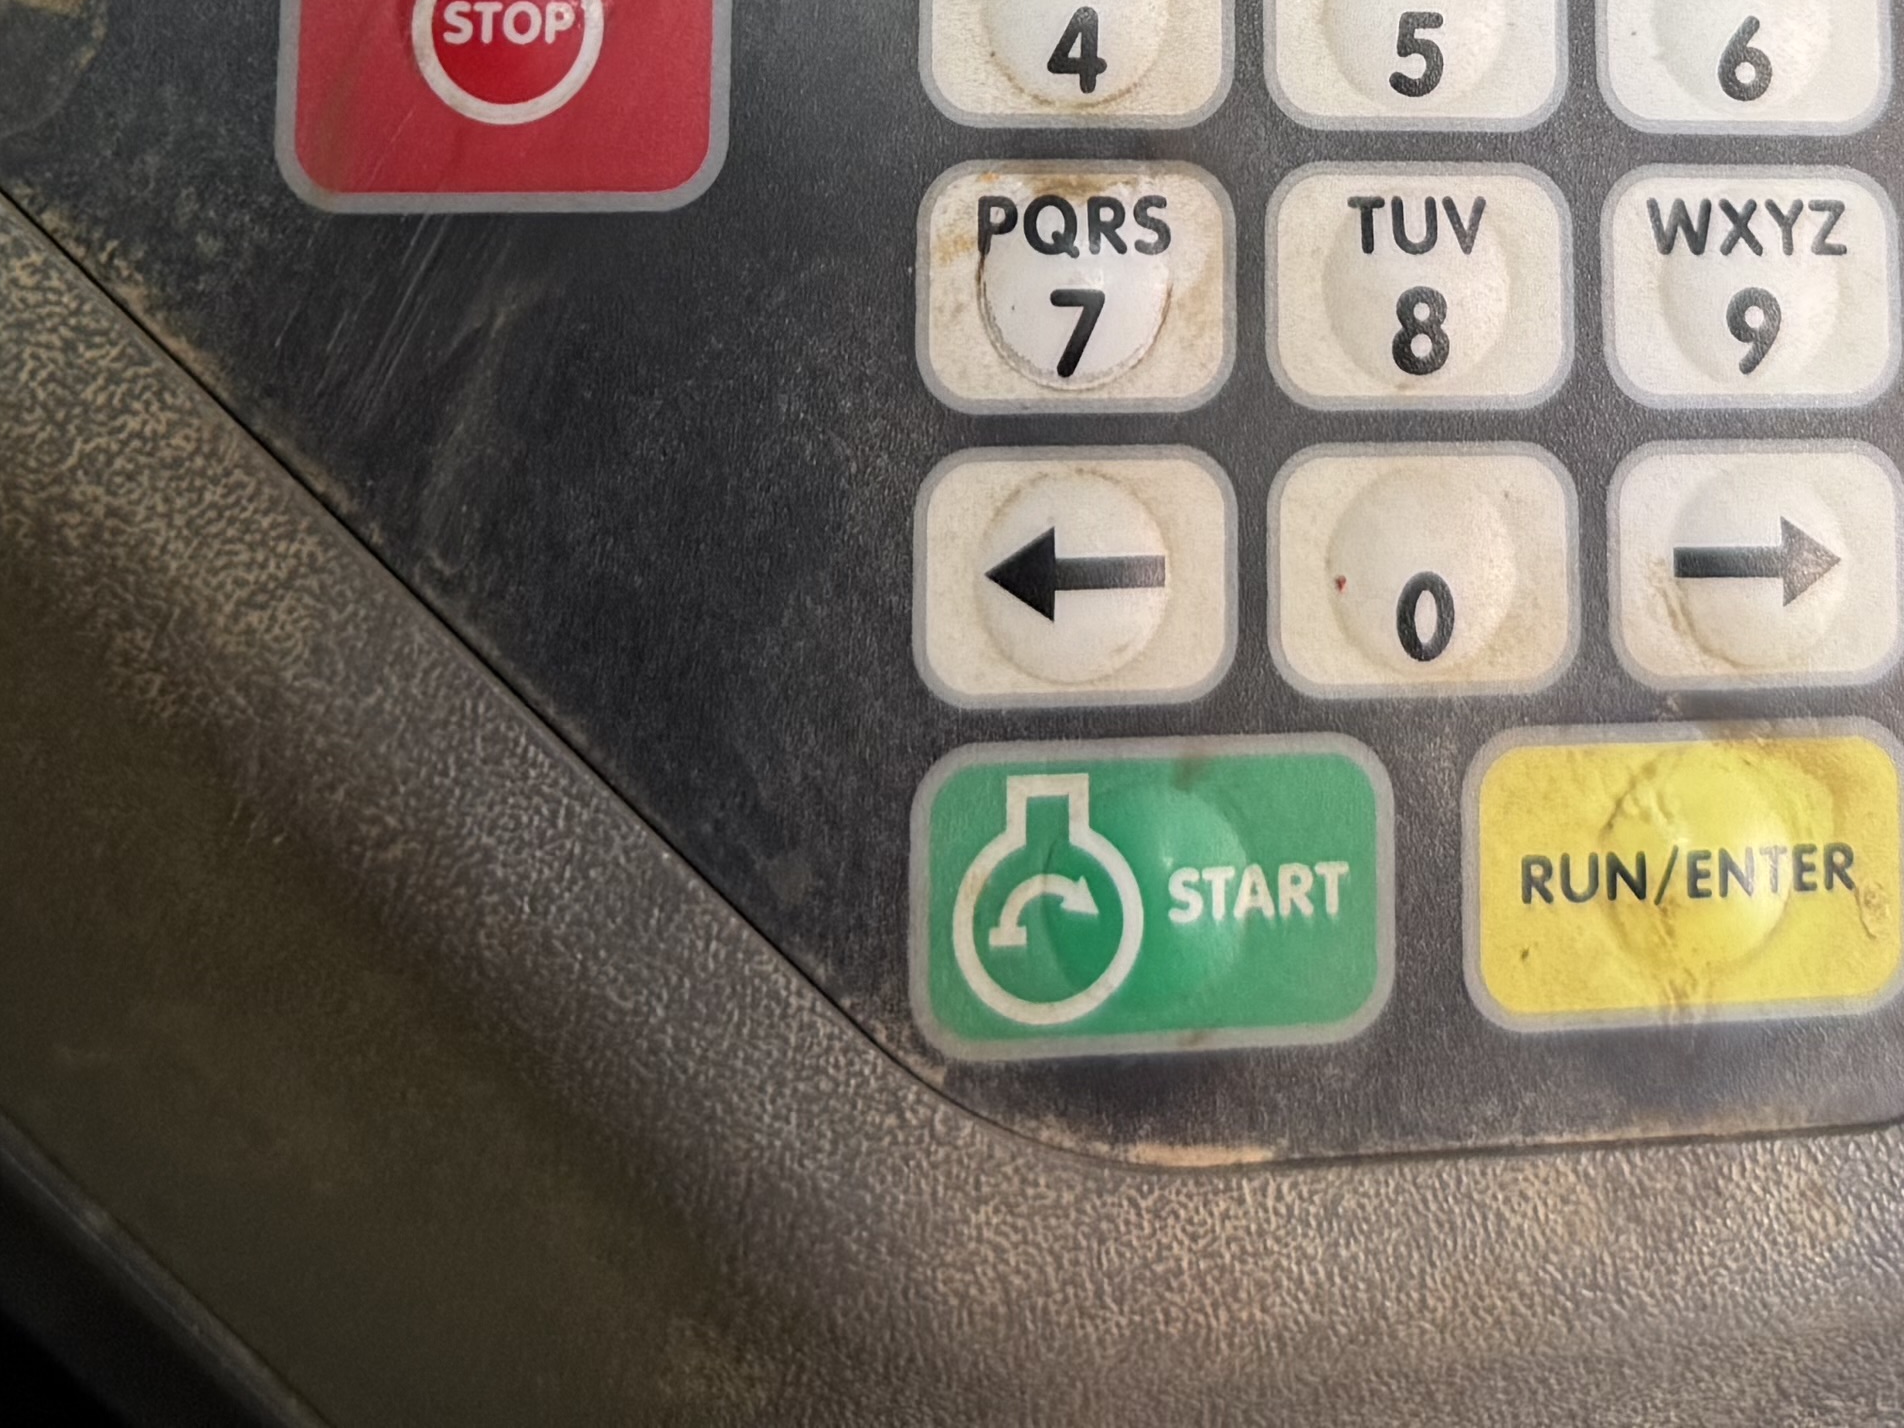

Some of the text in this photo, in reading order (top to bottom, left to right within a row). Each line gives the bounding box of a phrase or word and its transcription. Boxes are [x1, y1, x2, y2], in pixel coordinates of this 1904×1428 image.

[1046, 7, 1107, 95] 4
[1389, 11, 1445, 97] 5
[1719, 16, 1772, 101] 6
[978, 194, 1173, 259] PQRS
[1348, 195, 1487, 257] TUV
[1650, 198, 1848, 258] WXYZ
[1049, 288, 1106, 380] 7
[1391, 285, 1450, 377] 8
[1726, 288, 1782, 375] 9
[1396, 570, 1456, 661] 0
[1167, 858, 1353, 924] START
[1519, 838, 1858, 907] RUN/ENTER
